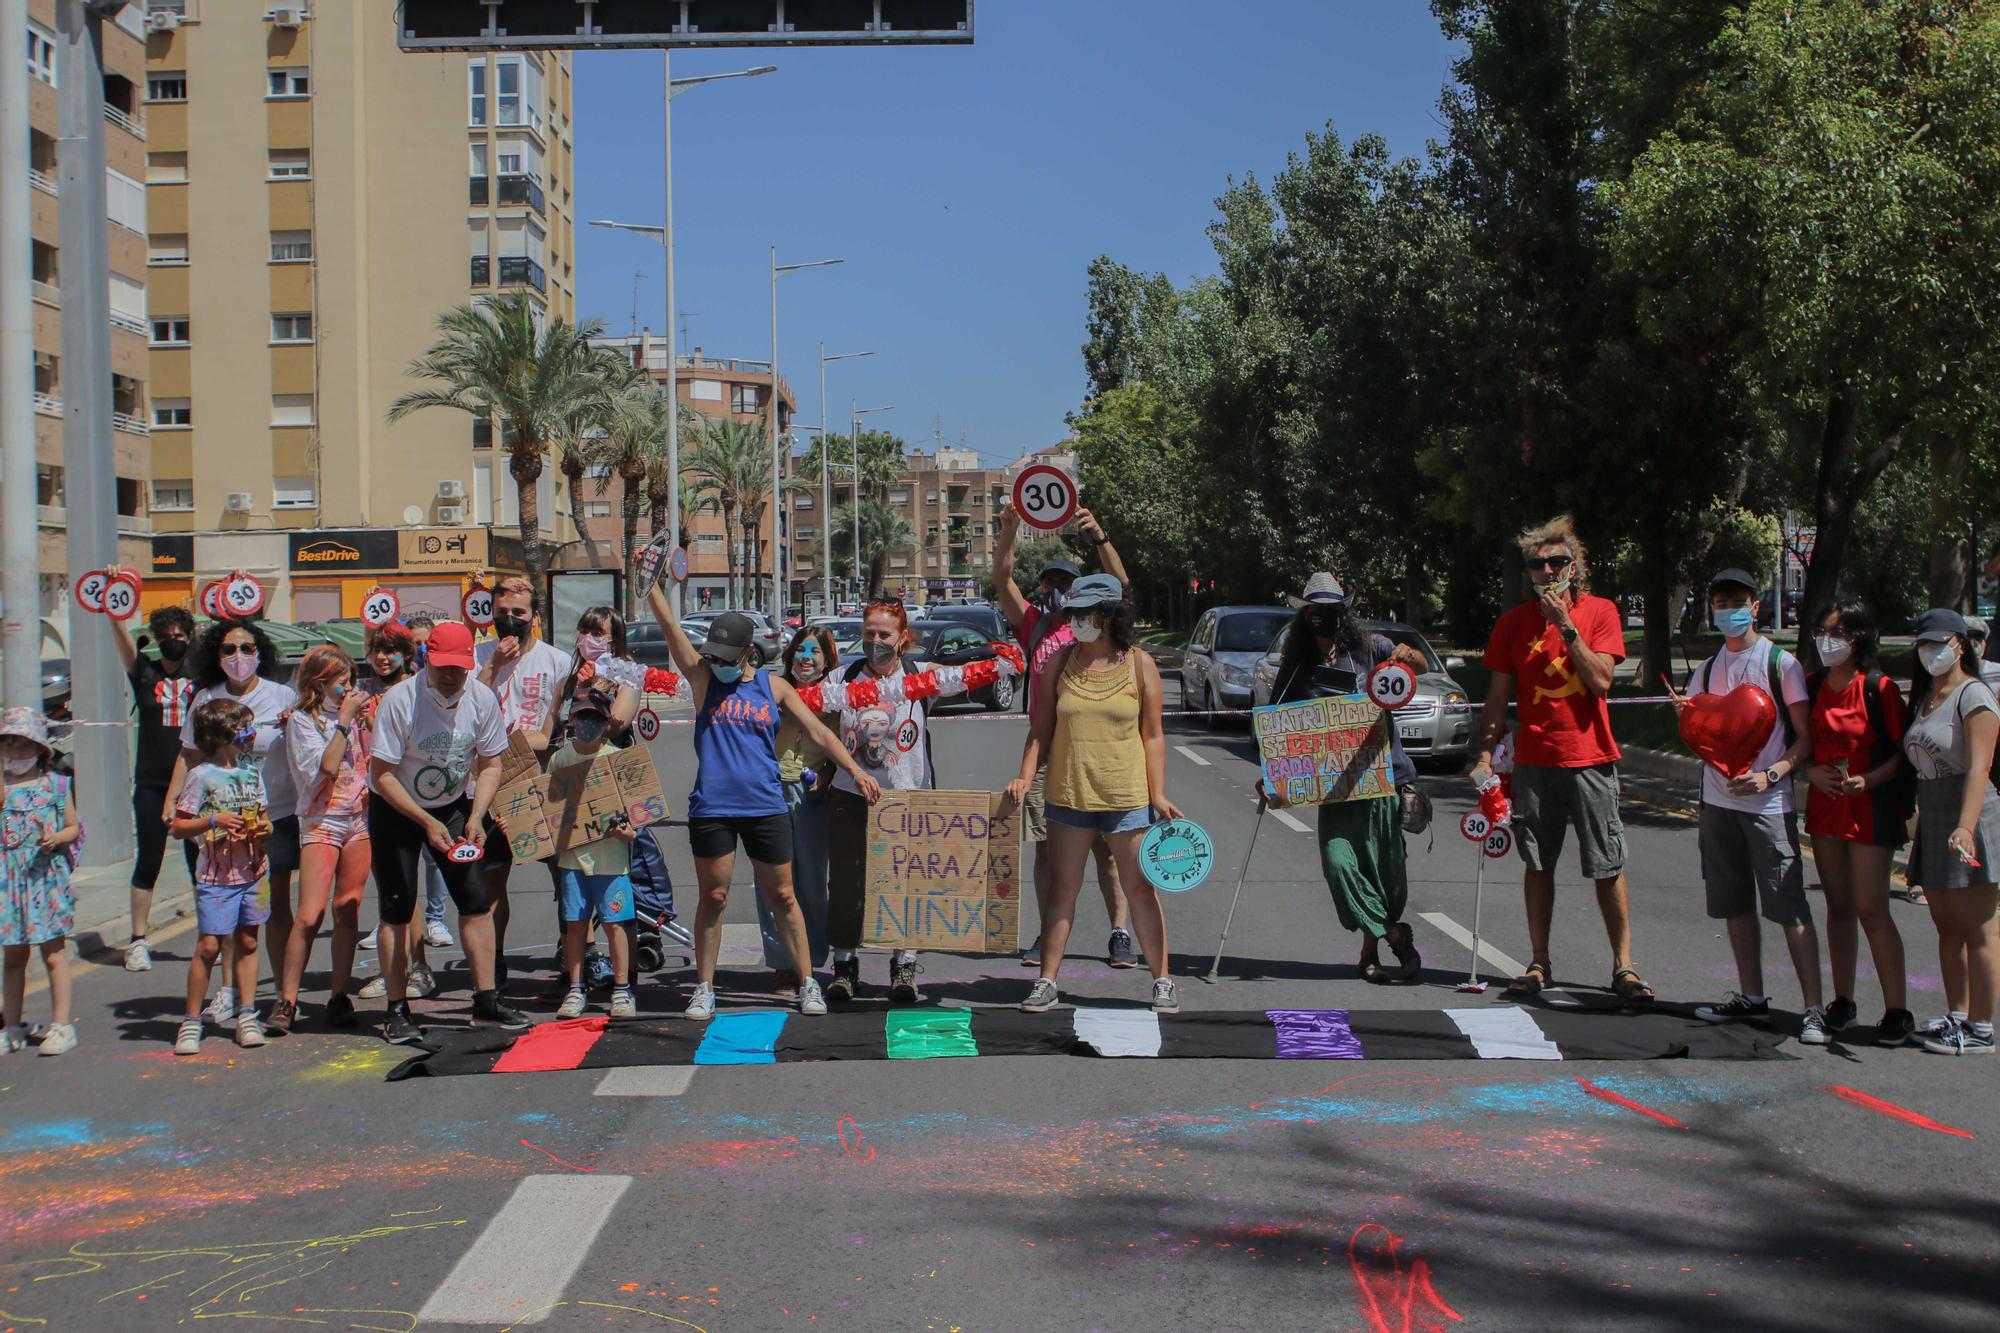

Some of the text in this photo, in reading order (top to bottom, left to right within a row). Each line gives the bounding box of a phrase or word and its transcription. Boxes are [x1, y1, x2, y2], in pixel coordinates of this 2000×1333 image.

[1024, 482, 1066, 512] 30
[296, 549, 361, 562] BestDrive
[404, 558, 444, 567] Neumáticos
[450, 557, 483, 566] Mecánica
[109, 590, 130, 610] 30
[231, 585, 256, 607] 30
[367, 598, 391, 620] 30
[399, 609, 450, 621] estDrive
[470, 599, 492, 617] 30
[1377, 676, 1406, 697] 30
[641, 717, 654, 733] 30
[1257, 697, 1381, 736] CUATRO PICOS
[900, 729, 913, 743] 30
[1401, 727, 1421, 737] FLF
[1262, 735, 1288, 759] SE
[1266, 755, 1317, 783] CADA
[1467, 819, 1486, 834] 30
[1487, 836, 1504, 850] 30
[456, 849, 476, 859] 30
[891, 845, 961, 880] PARA
